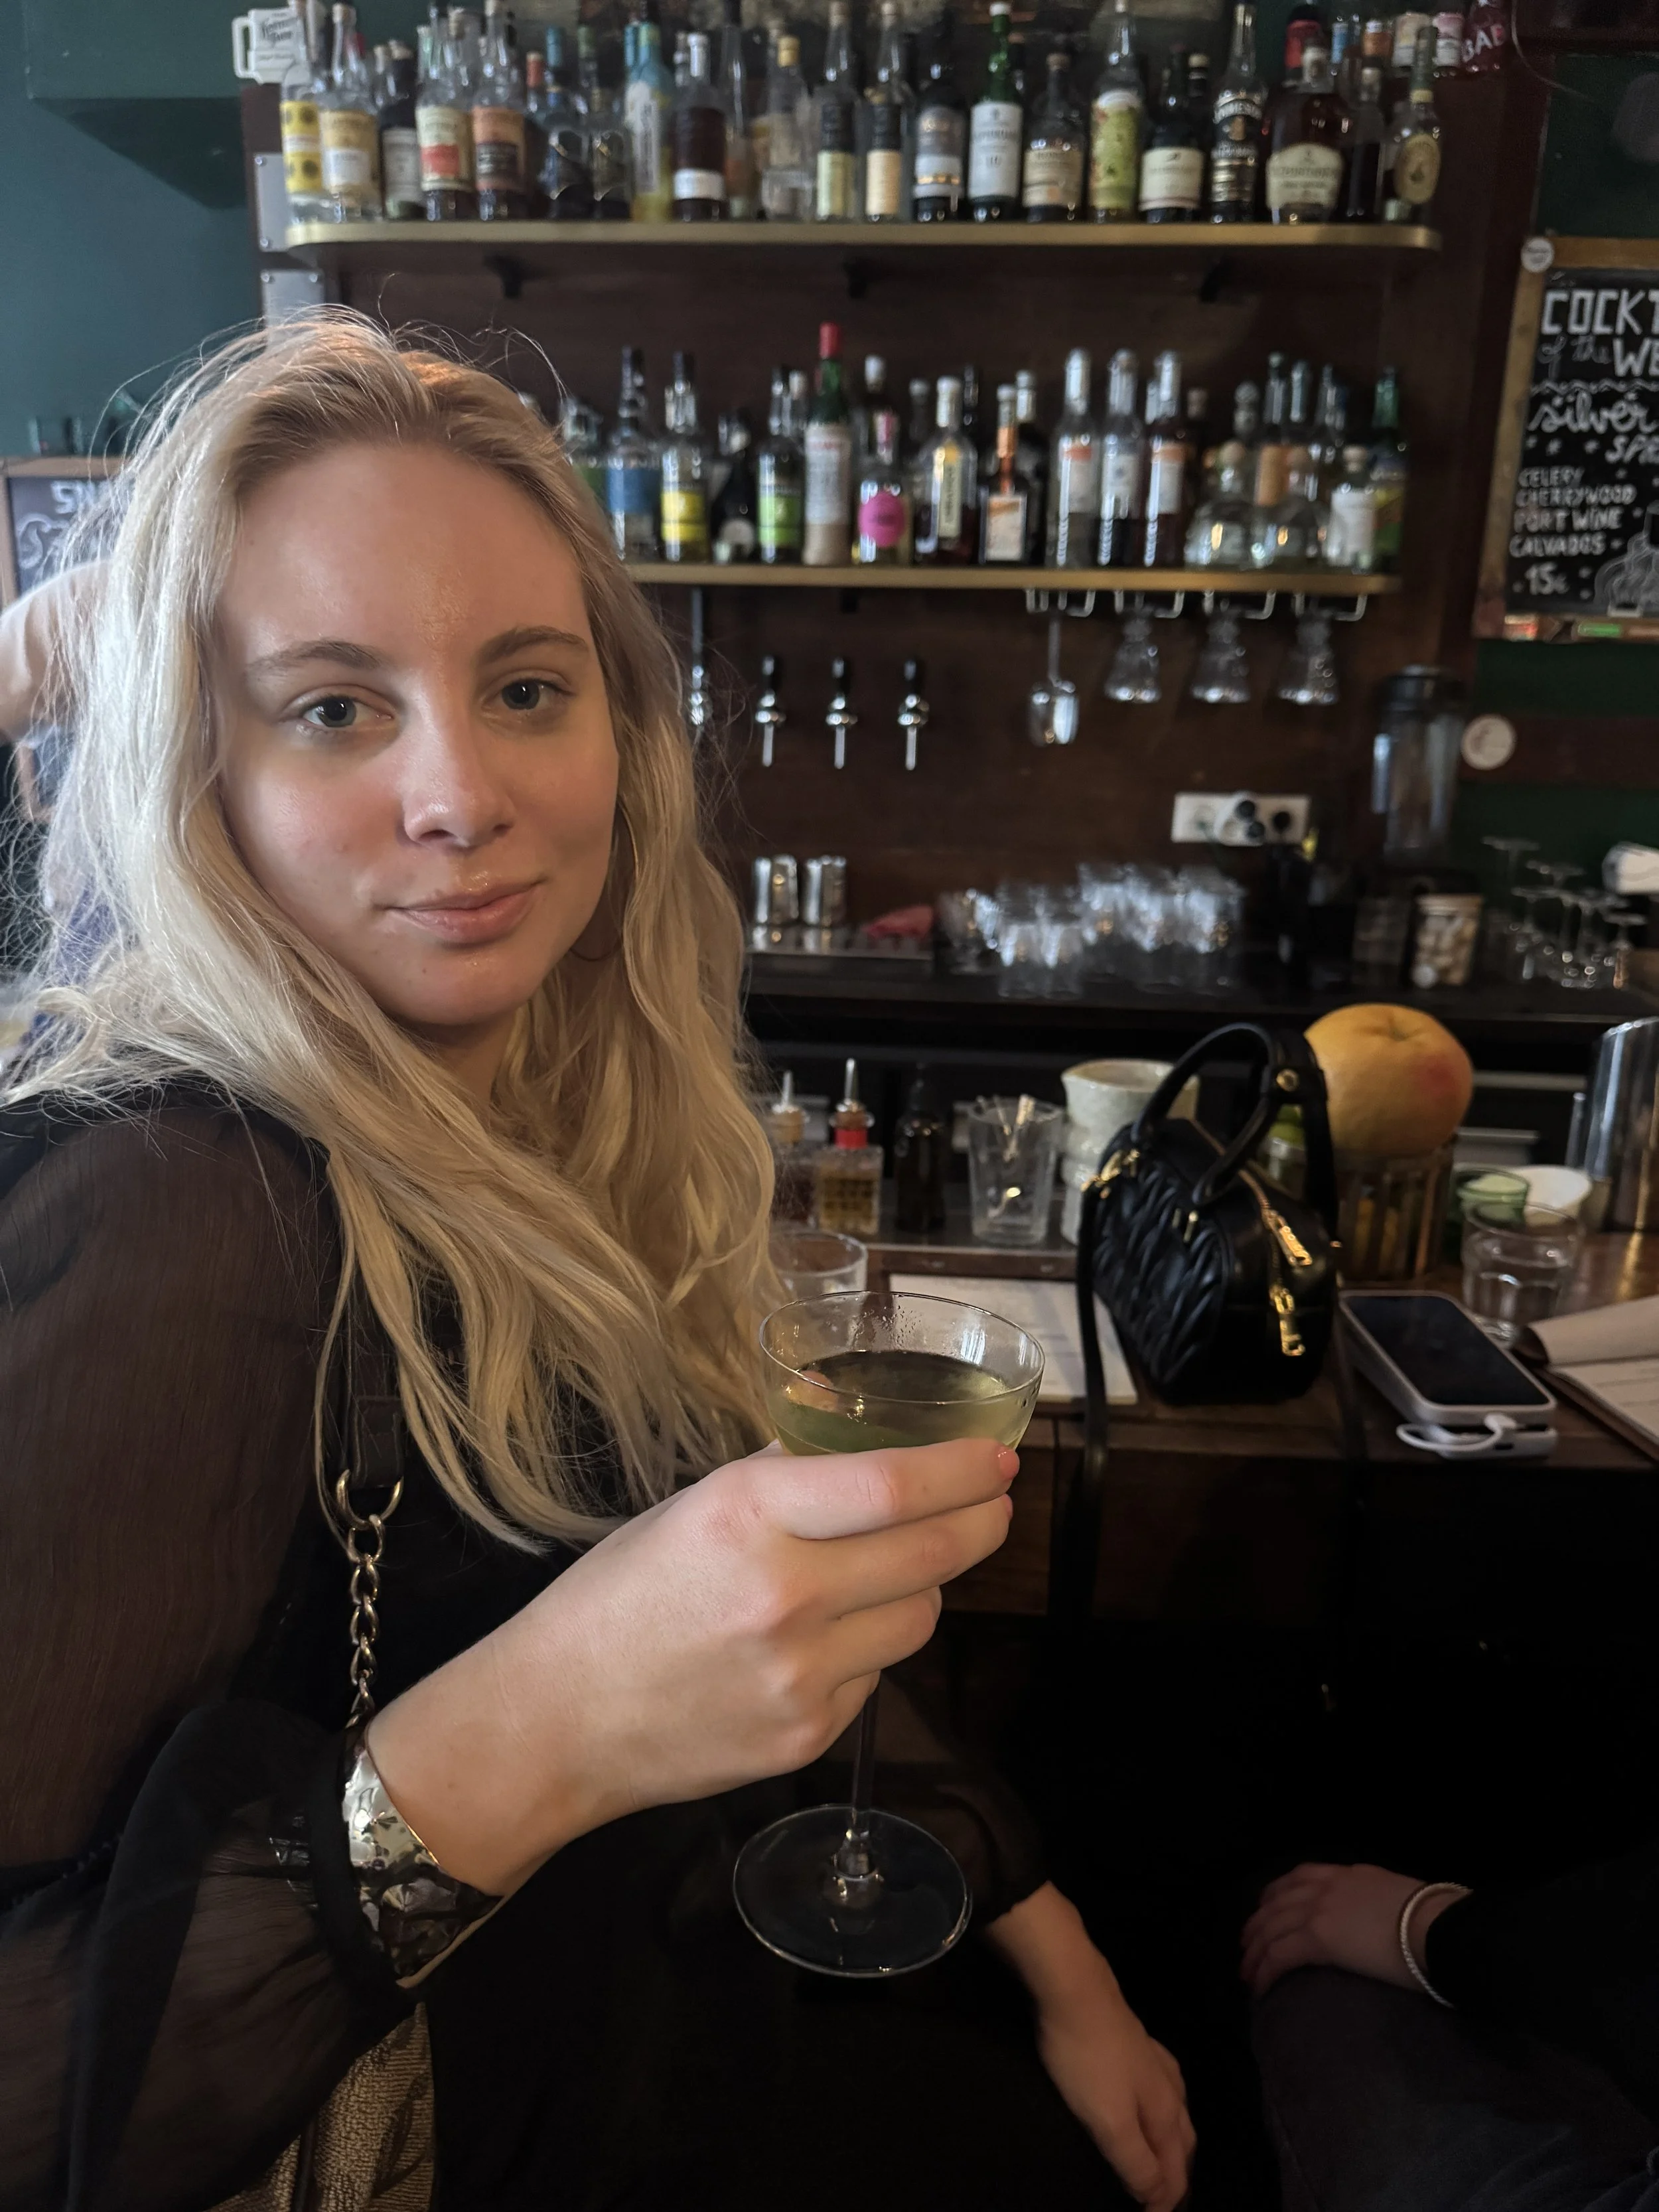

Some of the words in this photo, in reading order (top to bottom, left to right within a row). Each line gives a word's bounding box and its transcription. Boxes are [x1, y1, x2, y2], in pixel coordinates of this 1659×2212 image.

[1514, 506, 1570, 533] PORT
[1571, 506, 1624, 530] WINE
[1509, 532, 1607, 558] CALVADOS
